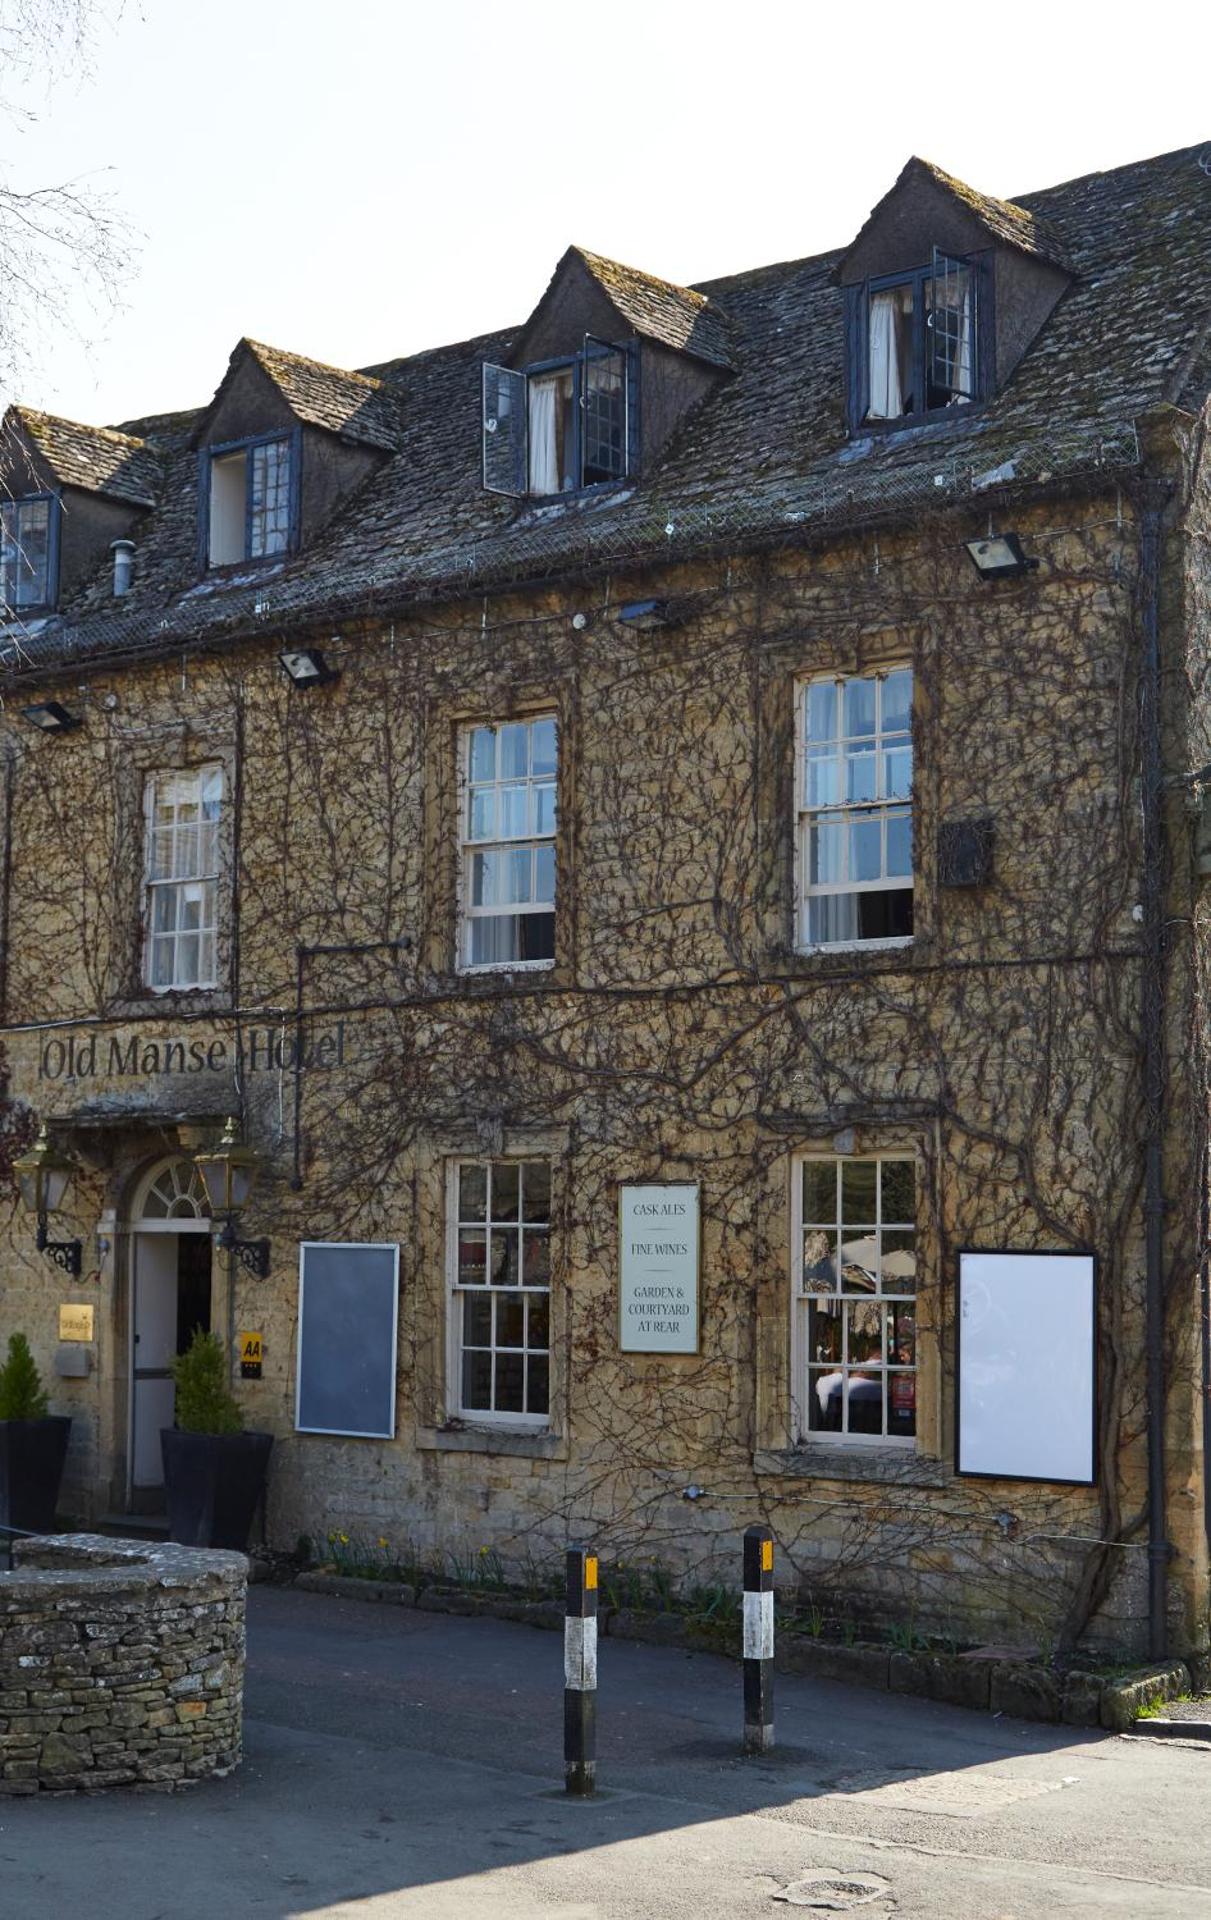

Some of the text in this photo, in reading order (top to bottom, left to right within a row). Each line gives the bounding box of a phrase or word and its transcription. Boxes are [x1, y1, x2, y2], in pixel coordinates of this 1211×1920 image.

[43, 1034, 97, 1079] Old
[106, 1035, 227, 1076] Manse
[633, 1204, 687, 1216] CASK ALES
[631, 1243, 688, 1255] FINE WINES
[633, 1286, 685, 1298] GARDEN &
[628, 1303, 690, 1316] COURTYARD
[637, 1320, 681, 1333] AT REAR
[243, 1340, 260, 1356] AA
